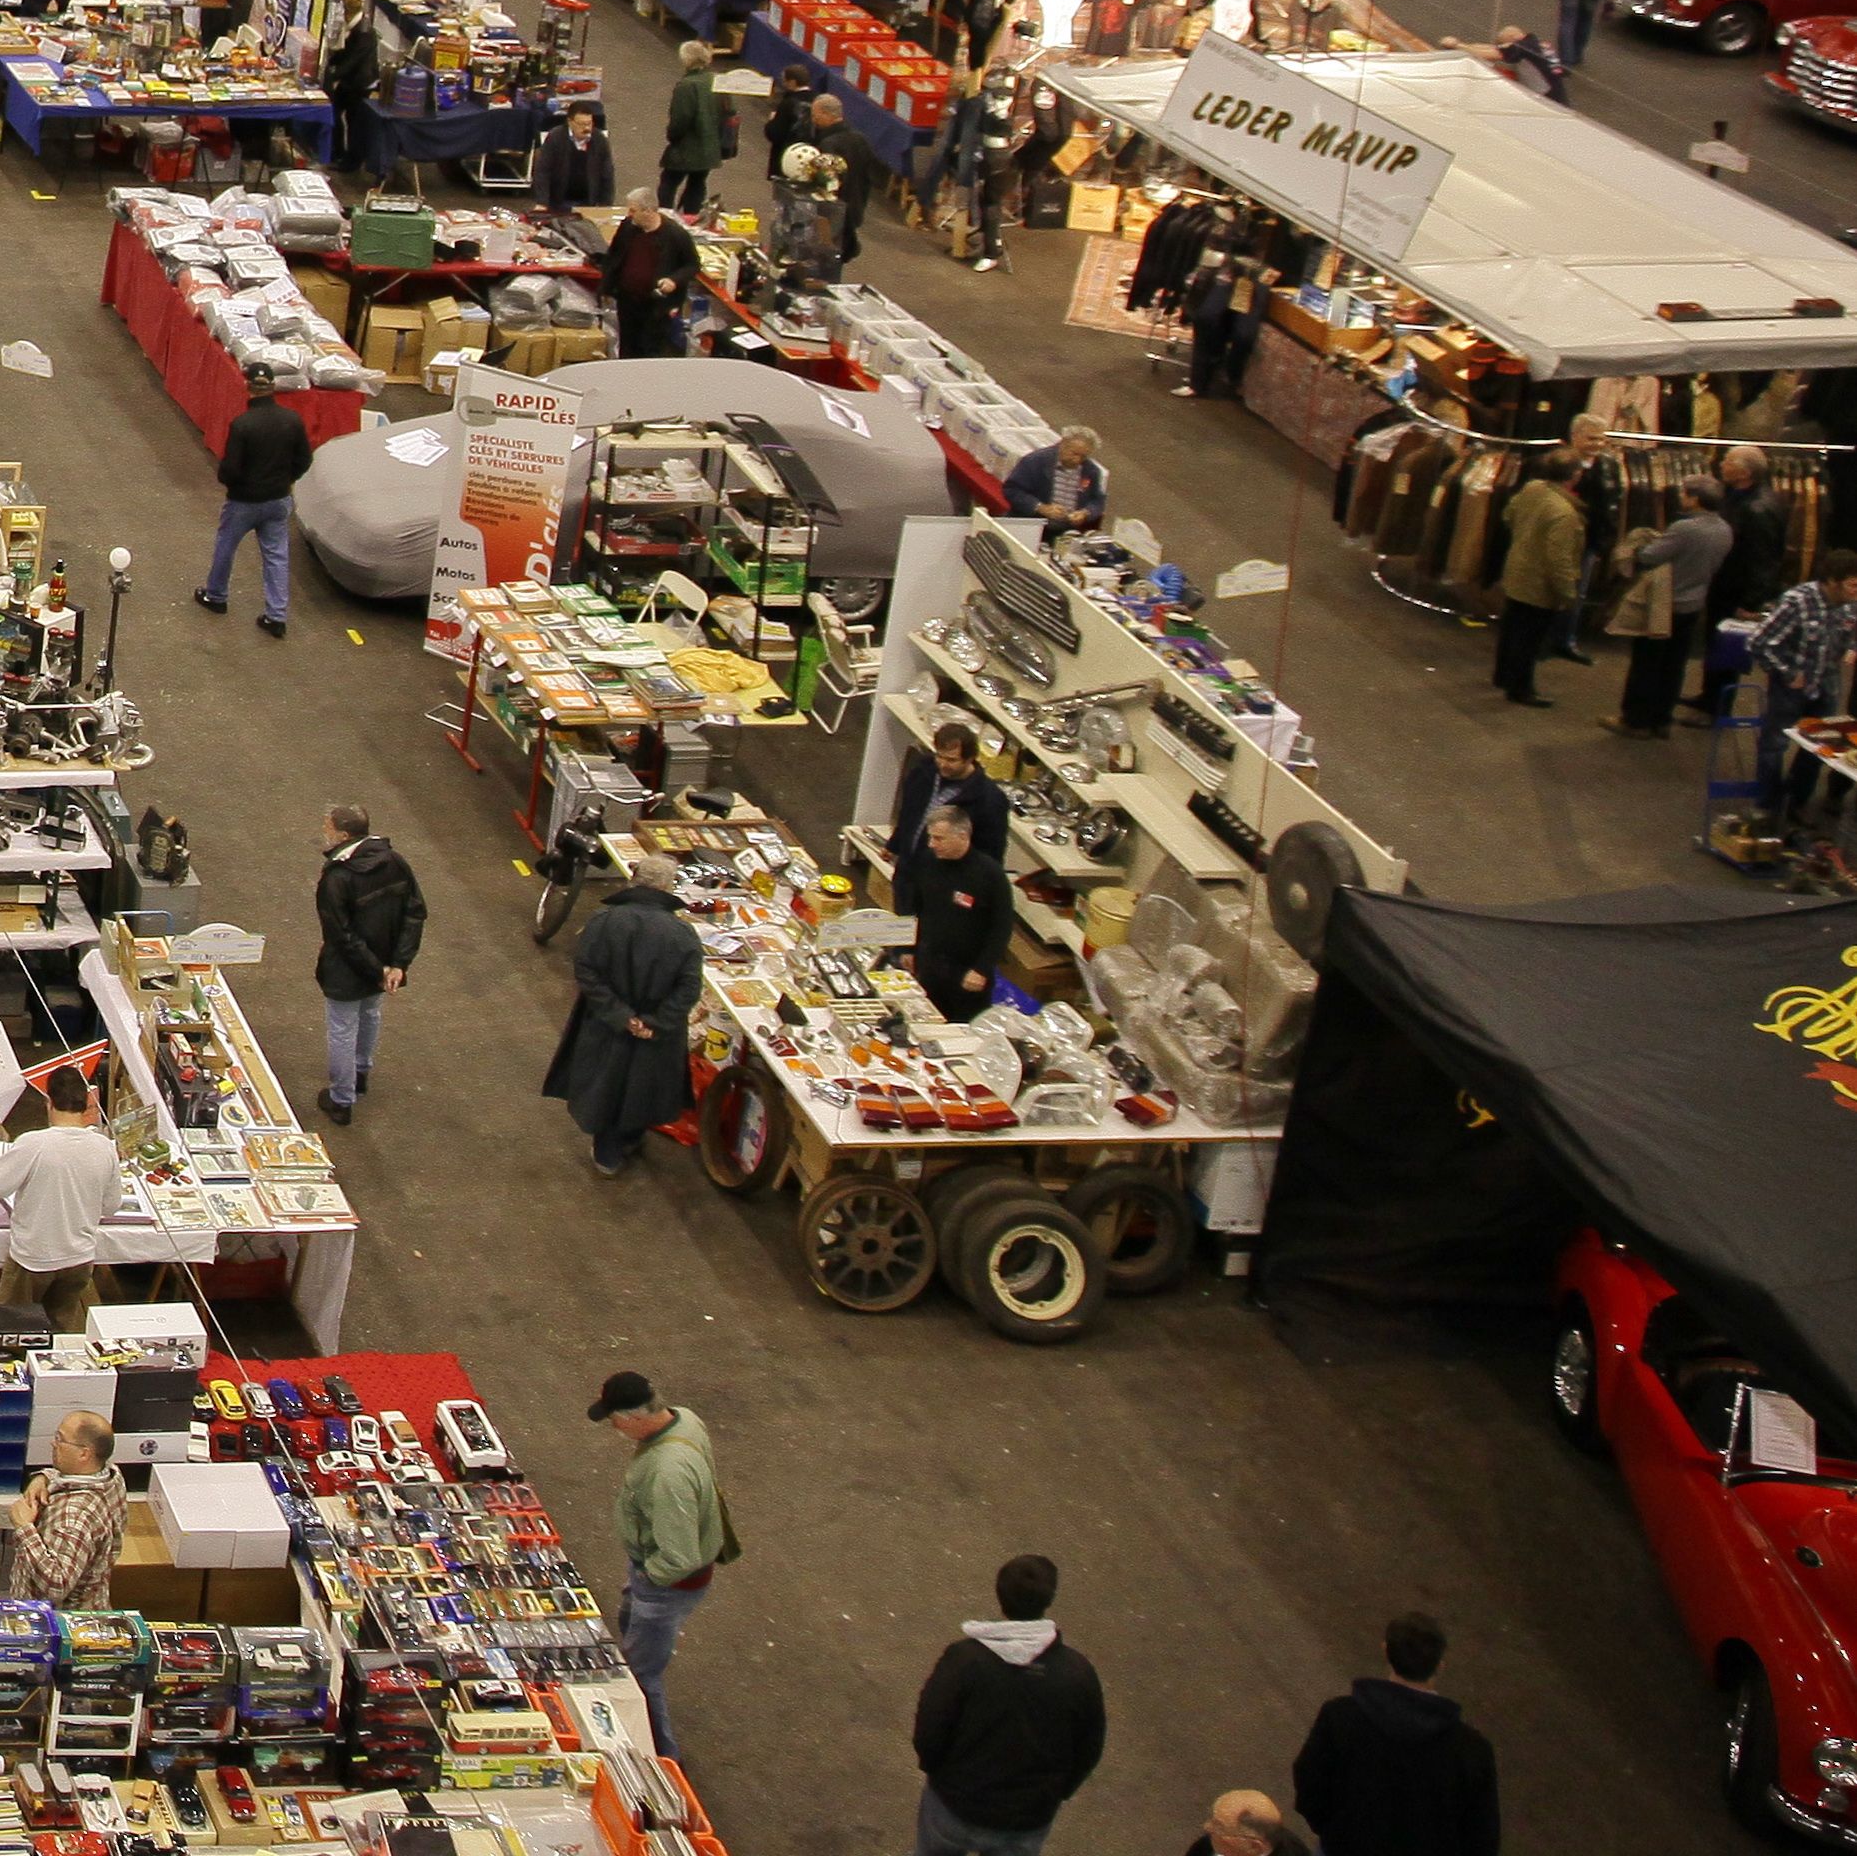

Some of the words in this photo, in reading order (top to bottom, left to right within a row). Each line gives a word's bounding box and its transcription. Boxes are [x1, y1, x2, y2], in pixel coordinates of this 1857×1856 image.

[1192, 92, 1292, 143] LEDER
[1299, 123, 1420, 175] MAVIP
[495, 393, 560, 412] RAPID'
[540, 409, 576, 426] CLÉS
[510, 450, 565, 466] SERRURES
[439, 536, 478, 552] Autos
[435, 566, 476, 582] Motos
